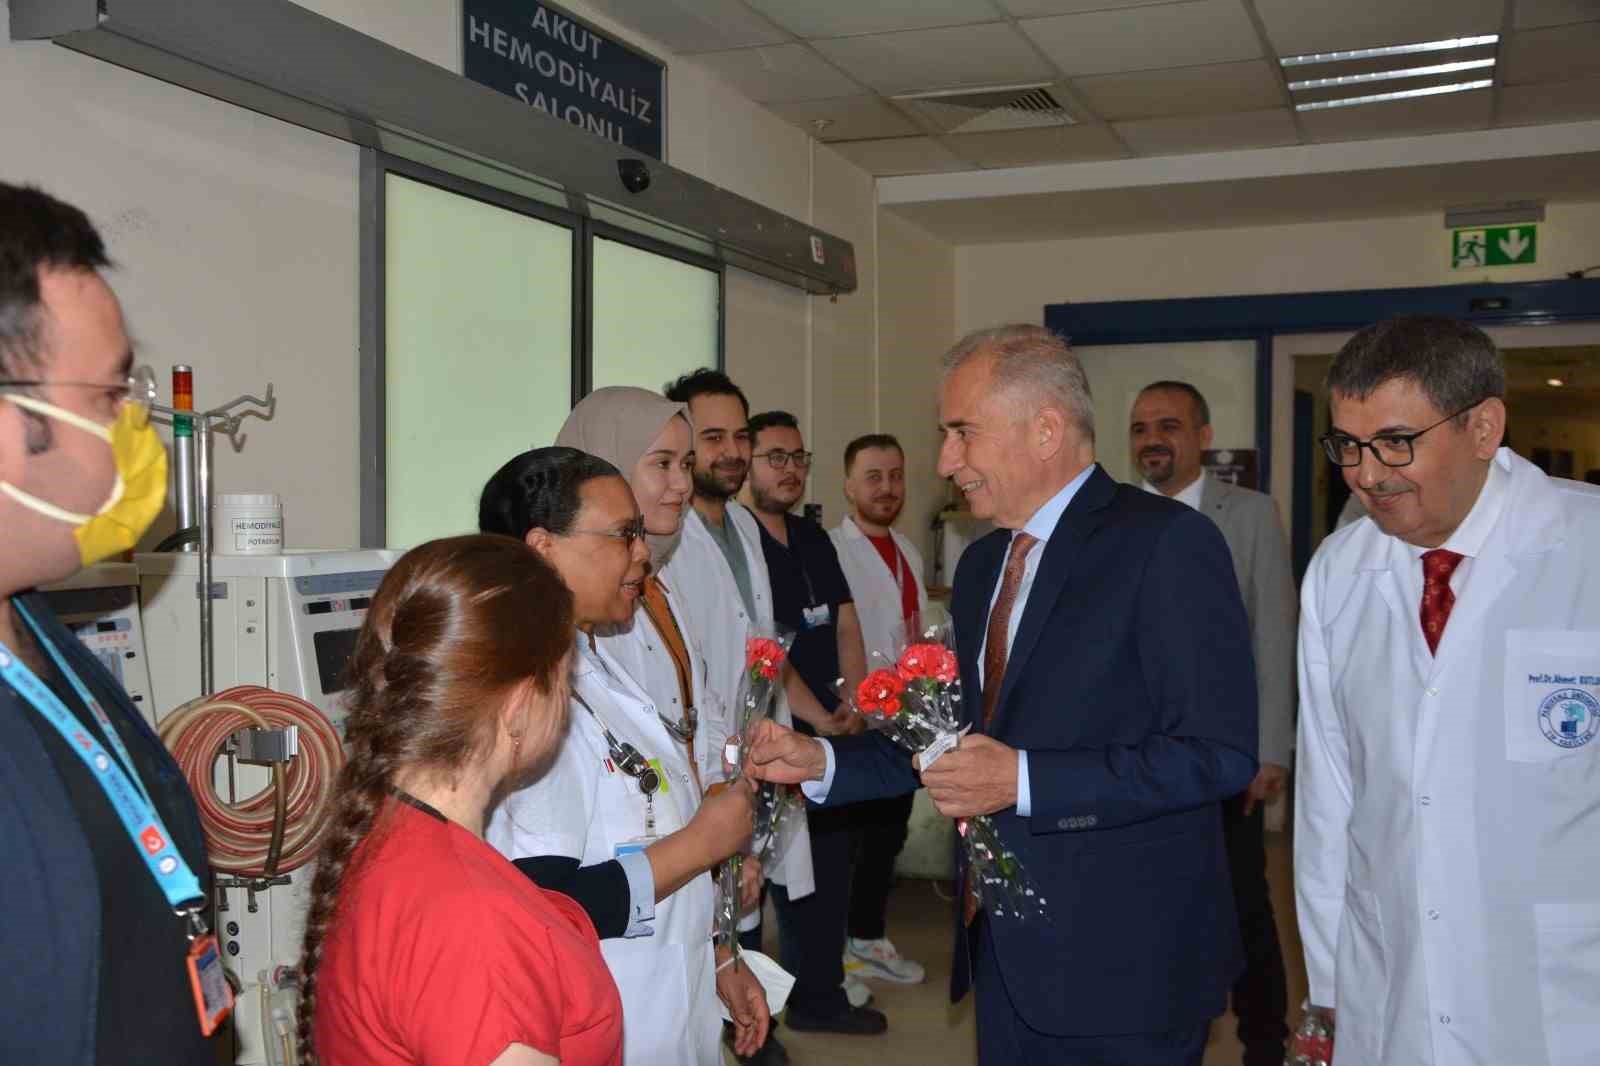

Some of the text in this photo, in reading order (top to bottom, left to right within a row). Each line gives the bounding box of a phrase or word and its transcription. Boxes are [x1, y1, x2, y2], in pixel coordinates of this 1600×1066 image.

[531, 6, 602, 60] AKUT
[469, 15, 652, 124] HEMODİYALİZ
[514, 82, 623, 145] SALONU
